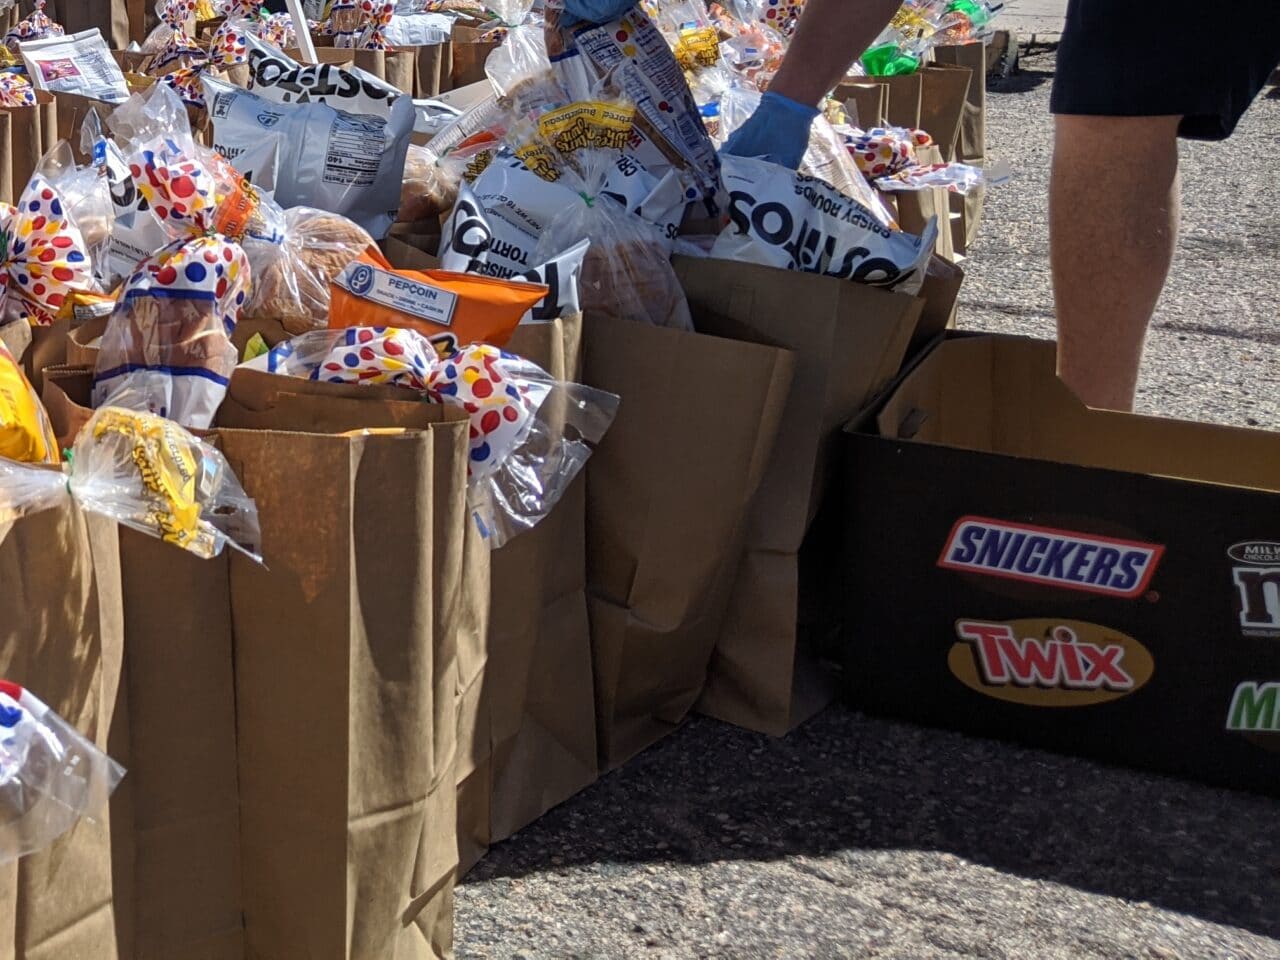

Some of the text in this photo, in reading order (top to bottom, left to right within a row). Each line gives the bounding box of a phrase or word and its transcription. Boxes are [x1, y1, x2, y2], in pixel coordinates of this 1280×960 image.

[327, 156, 343, 164] 140
[794, 185, 891, 239] ROUNDS CRISPY
[488, 237, 529, 266] TORTI
[388, 277, 439, 301] PEPCOIN
[951, 524, 1147, 590] SNICKERS
[961, 623, 1132, 688] Twix
